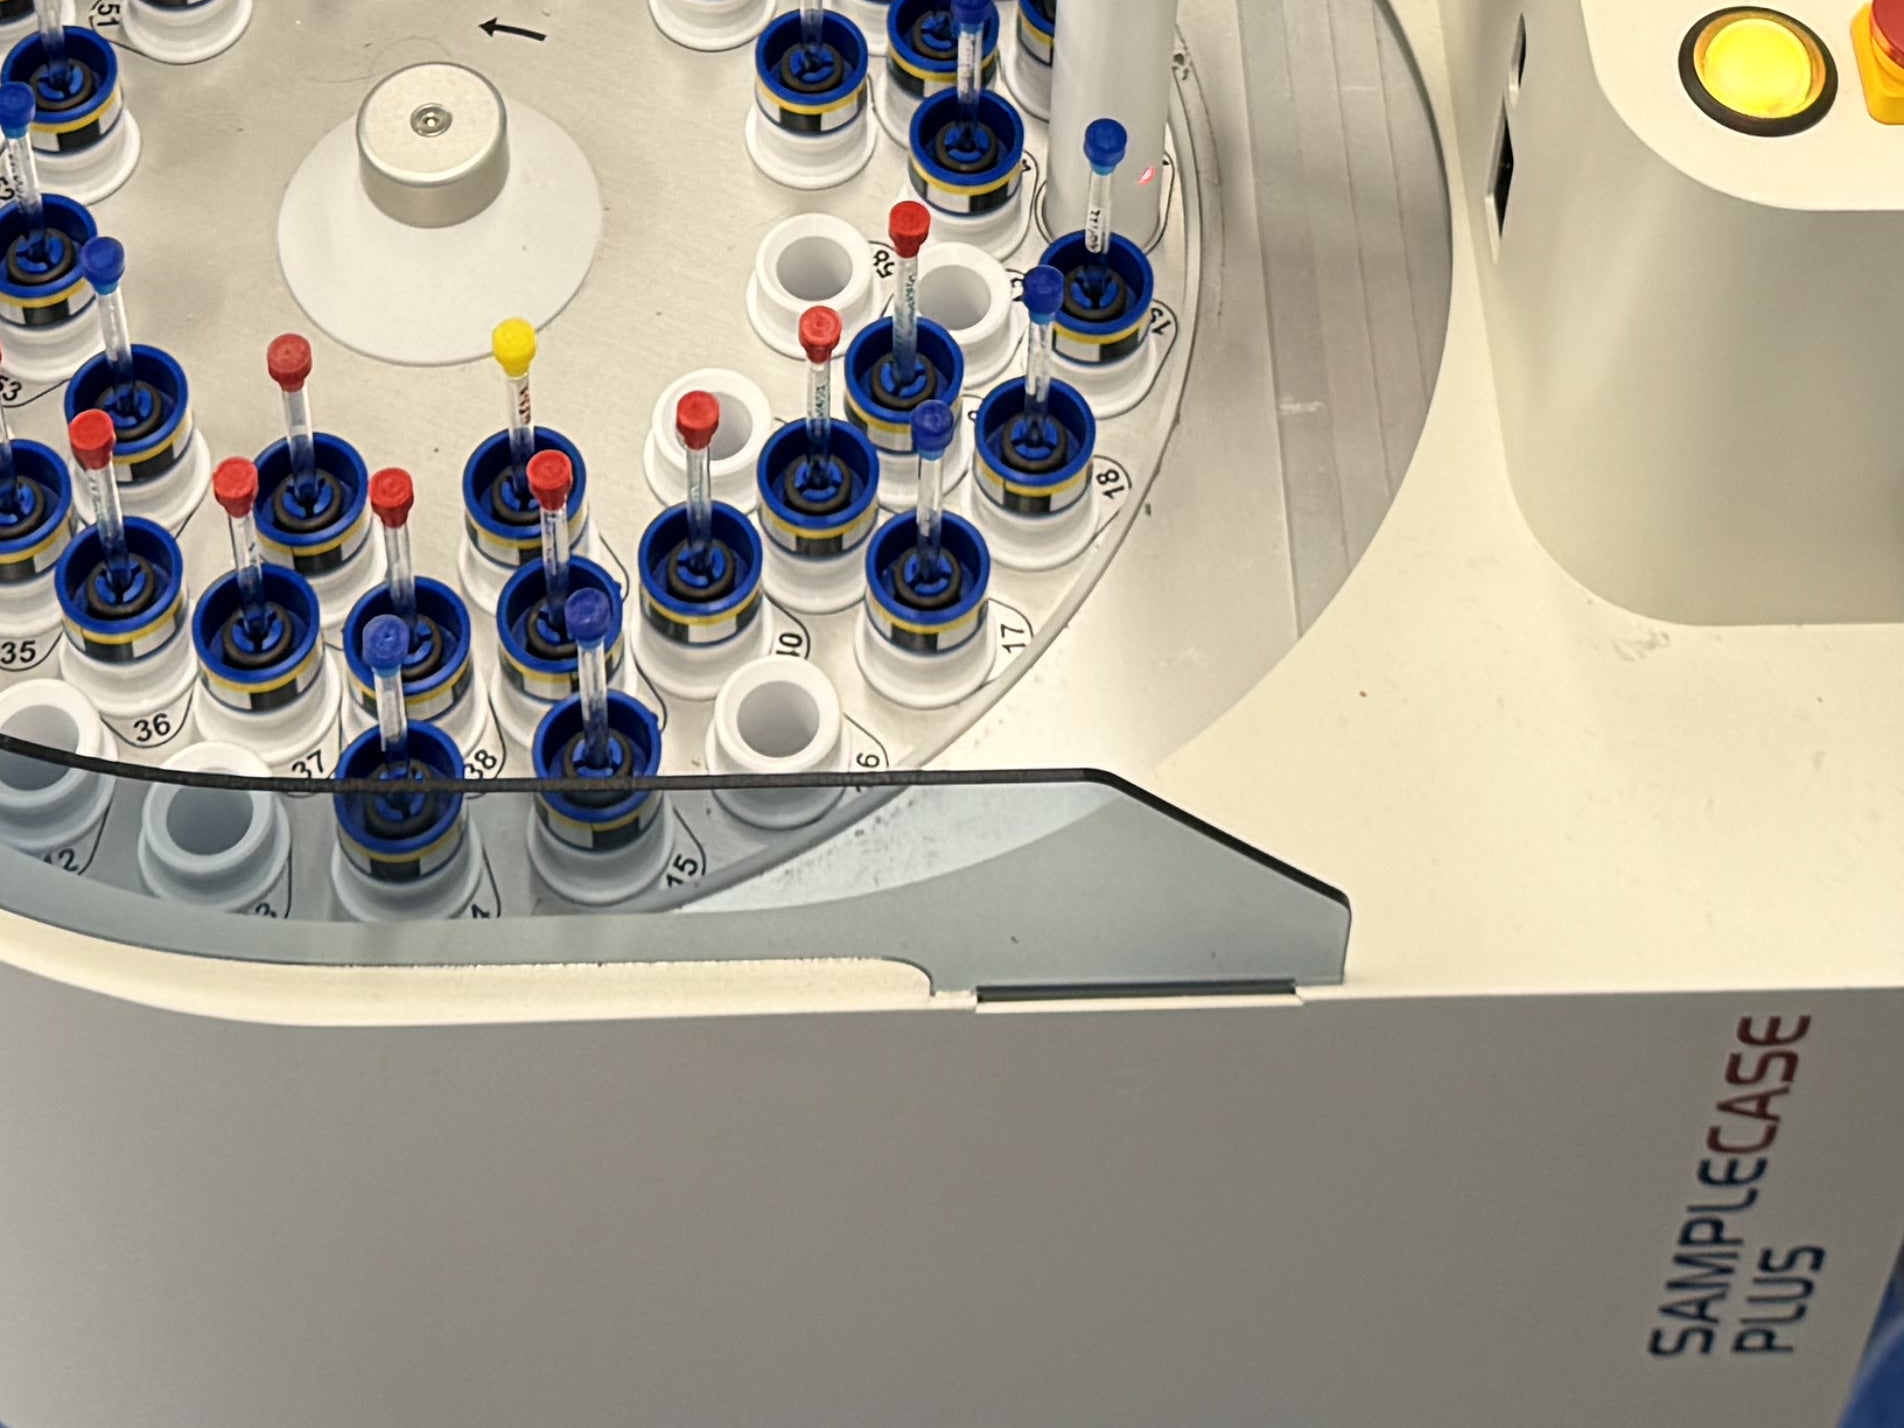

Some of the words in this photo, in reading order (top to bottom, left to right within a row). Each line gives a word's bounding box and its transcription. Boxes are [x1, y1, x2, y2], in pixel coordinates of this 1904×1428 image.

[97, 1, 121, 28] 51
[873, 248, 895, 280] 58
[1095, 467, 1126, 501] 18
[0, 639, 36, 665] 35
[999, 622, 1028, 655] 17
[132, 711, 172, 744] 36
[290, 748, 326, 779] 37
[665, 852, 699, 892] 15
[1649, 1014, 1813, 1359] SAMPLECASE
[1731, 1244, 1826, 1354] PLUS
